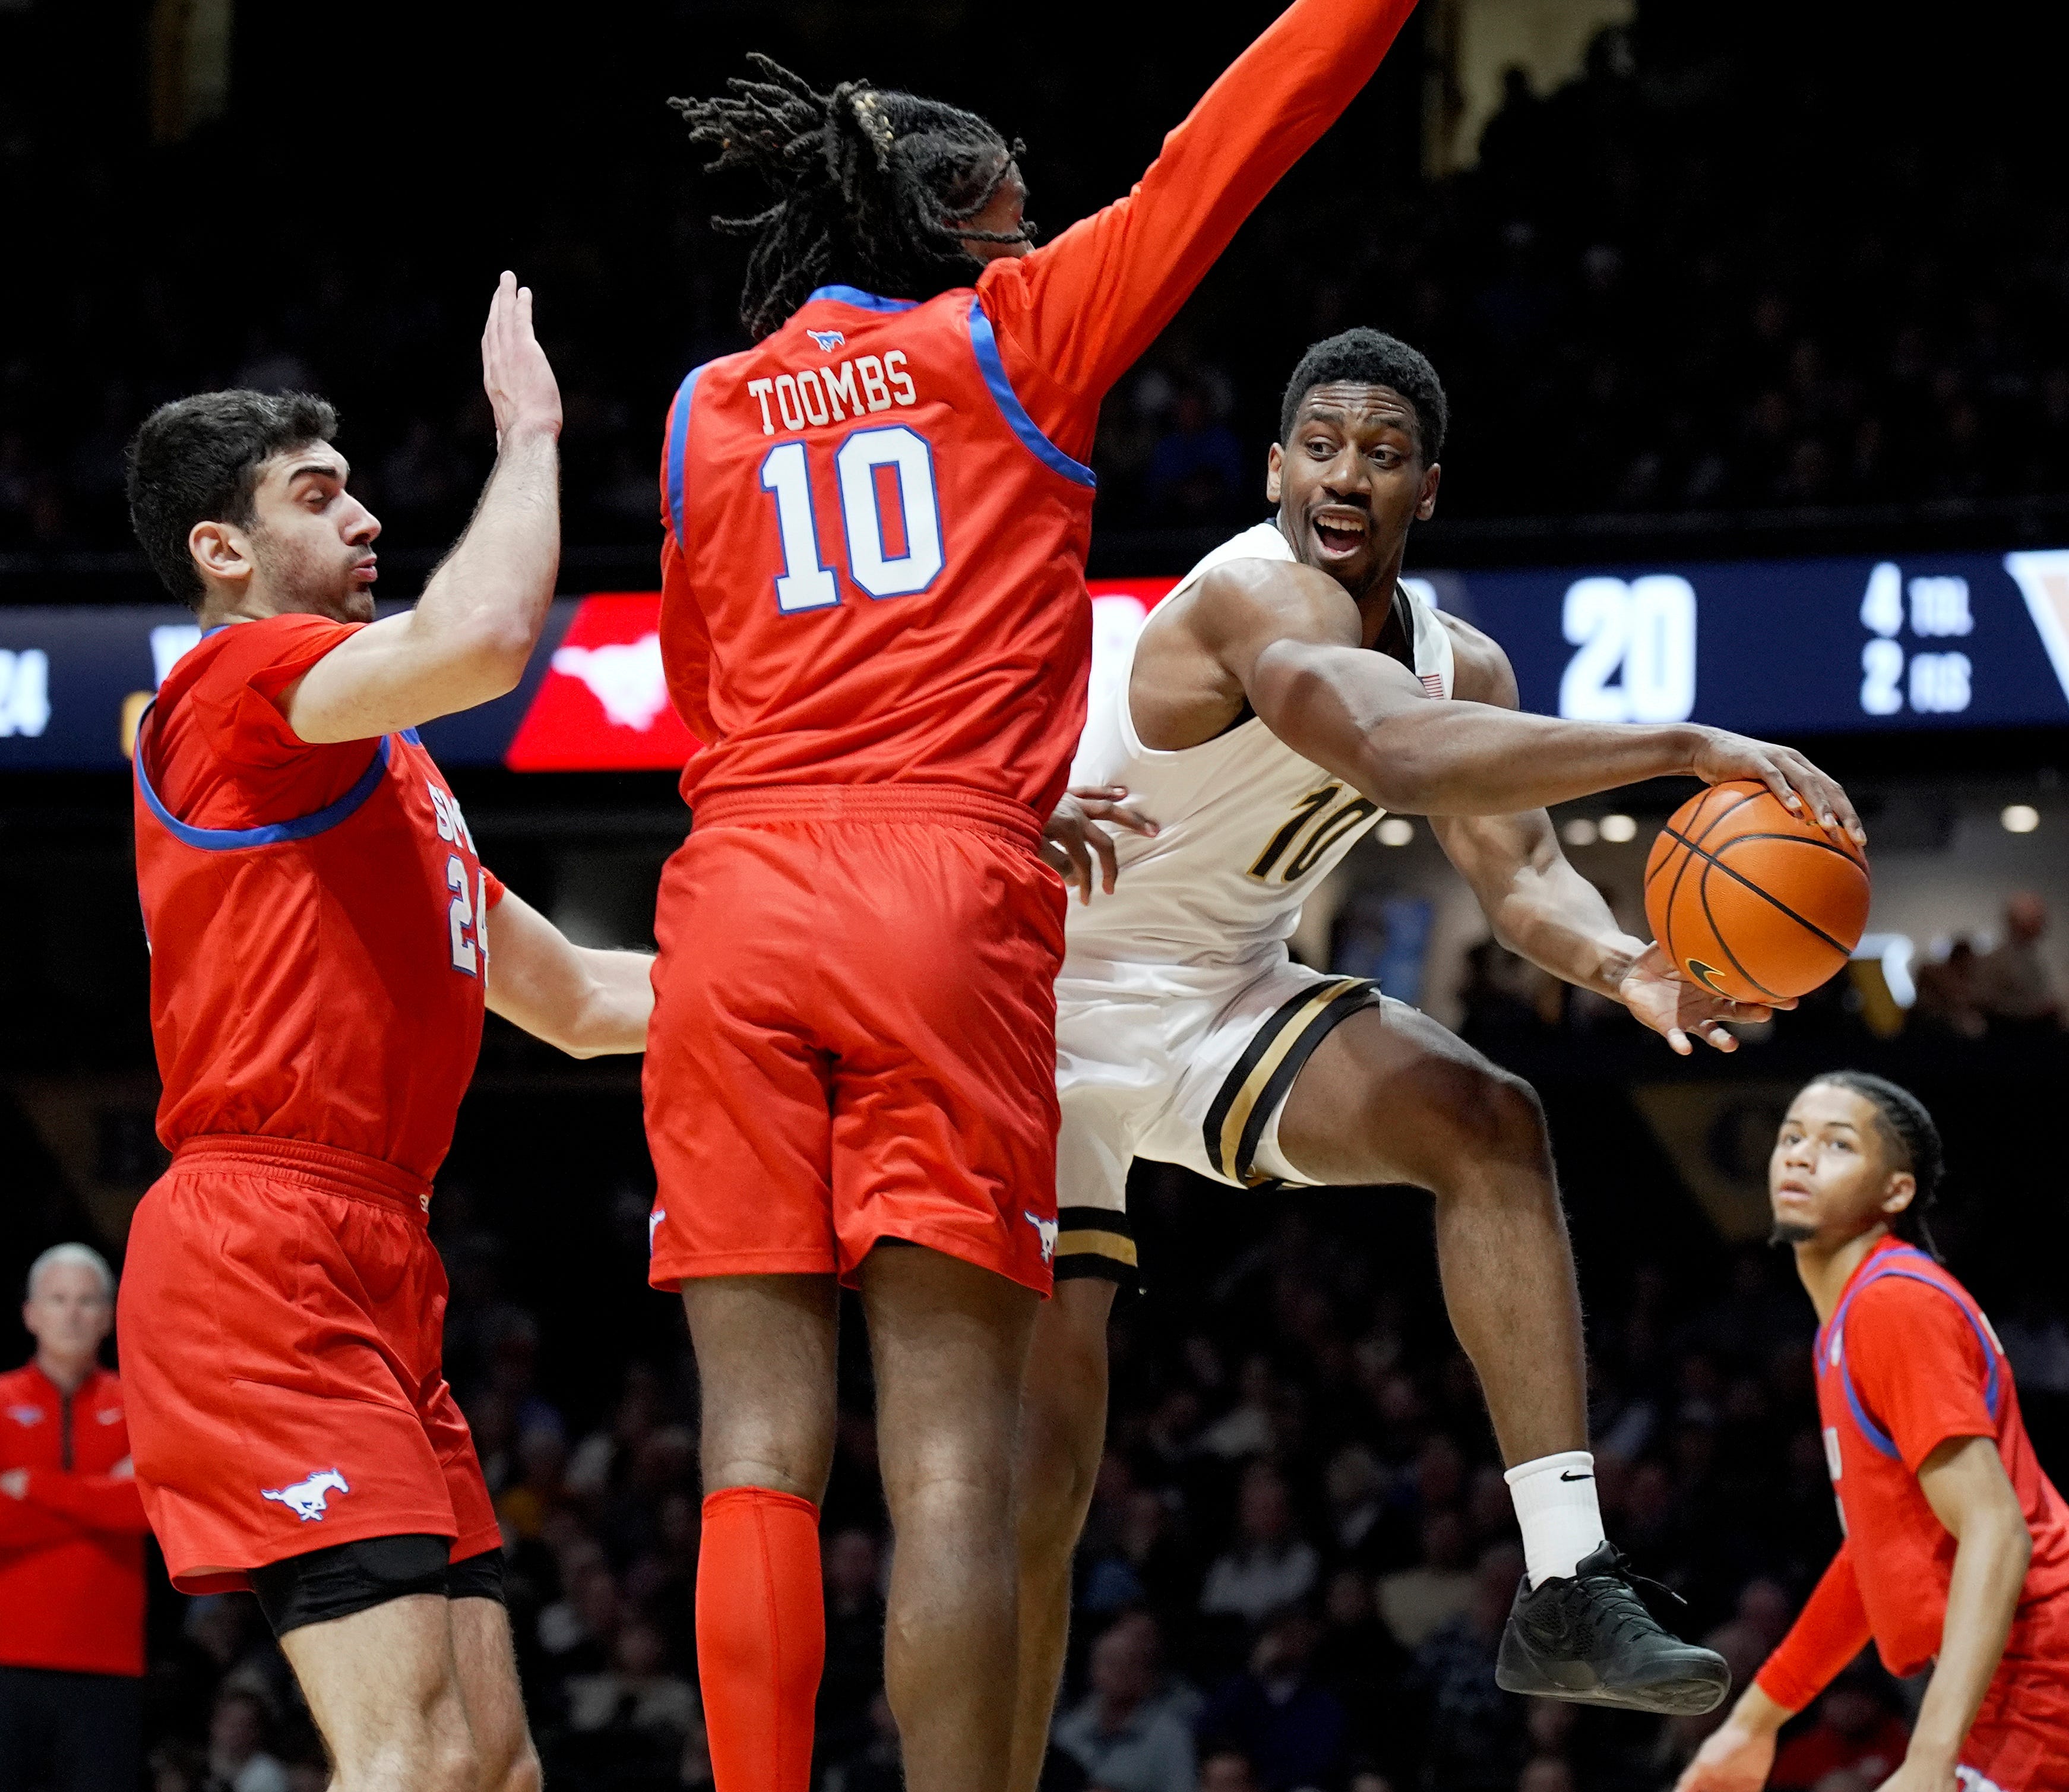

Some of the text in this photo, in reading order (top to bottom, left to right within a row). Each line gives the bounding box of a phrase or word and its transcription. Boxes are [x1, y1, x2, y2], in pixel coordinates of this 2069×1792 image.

[748, 350, 916, 435] TOOMBS
[758, 425, 946, 615] 10
[1859, 562, 1904, 638] 4
[1560, 575, 1697, 723] 20
[1859, 637, 1904, 715] 2
[426, 779, 479, 858] SM
[1246, 782, 1379, 883] 10
